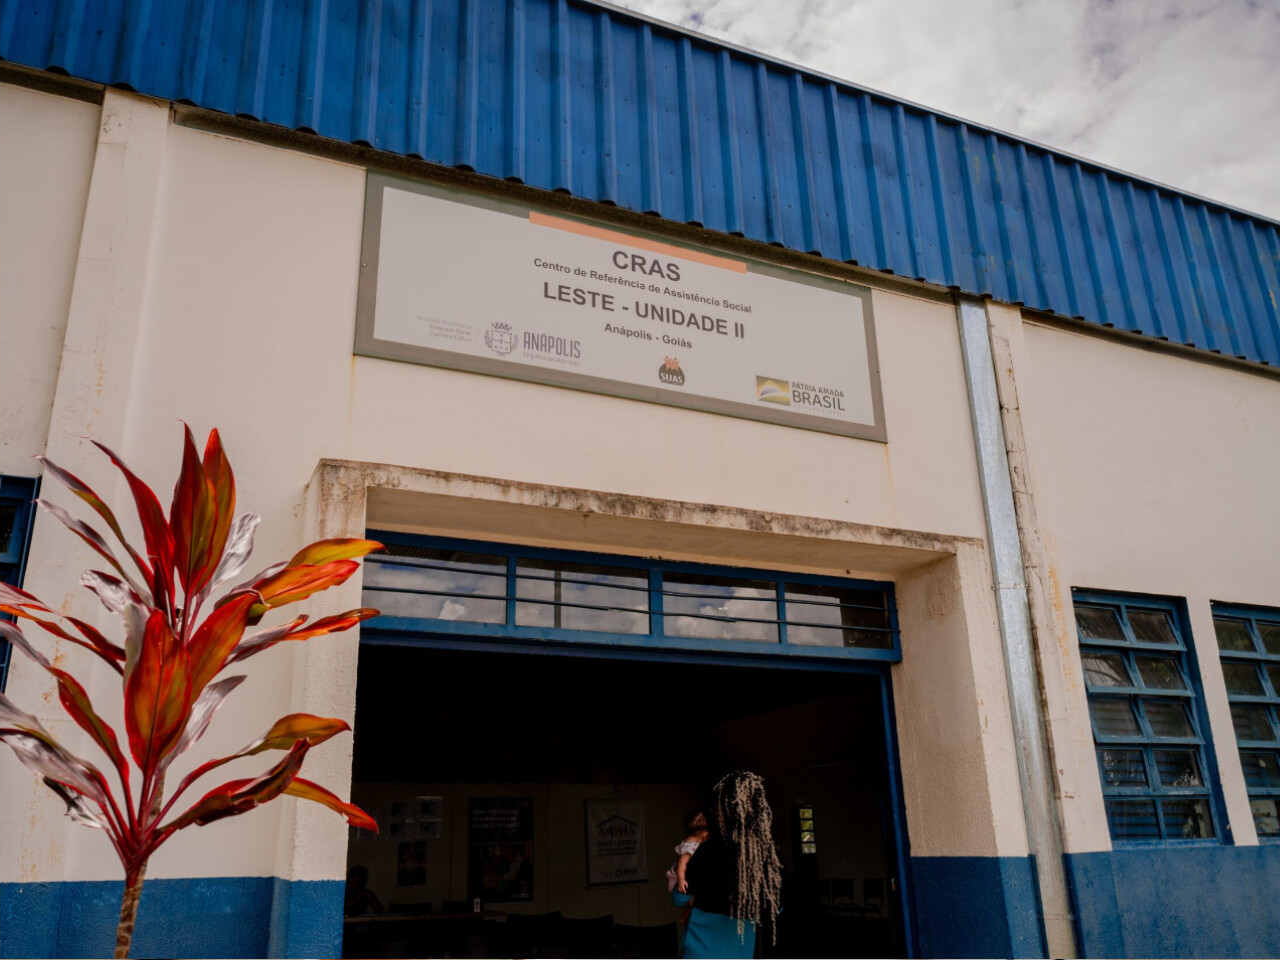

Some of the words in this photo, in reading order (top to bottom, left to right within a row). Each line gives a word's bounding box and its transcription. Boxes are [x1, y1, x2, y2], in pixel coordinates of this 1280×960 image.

[612, 251, 680, 281] CRAS
[534, 258, 571, 273] Centro
[574, 267, 587, 277] de
[590, 270, 645, 289] Referência
[648, 283, 660, 293] de
[663, 287, 720, 307] Assistência
[722, 300, 752, 313] Social
[544, 282, 614, 311] LESTE
[635, 301, 728, 335] UNIDADE
[734, 322, 744, 339] II
[604, 323, 652, 341] Anápolis
[662, 334, 692, 349] Goiás
[660, 373, 683, 384] SUAS
[792, 390, 845, 411] BRASIL
[818, 387, 844, 398] AMADA
